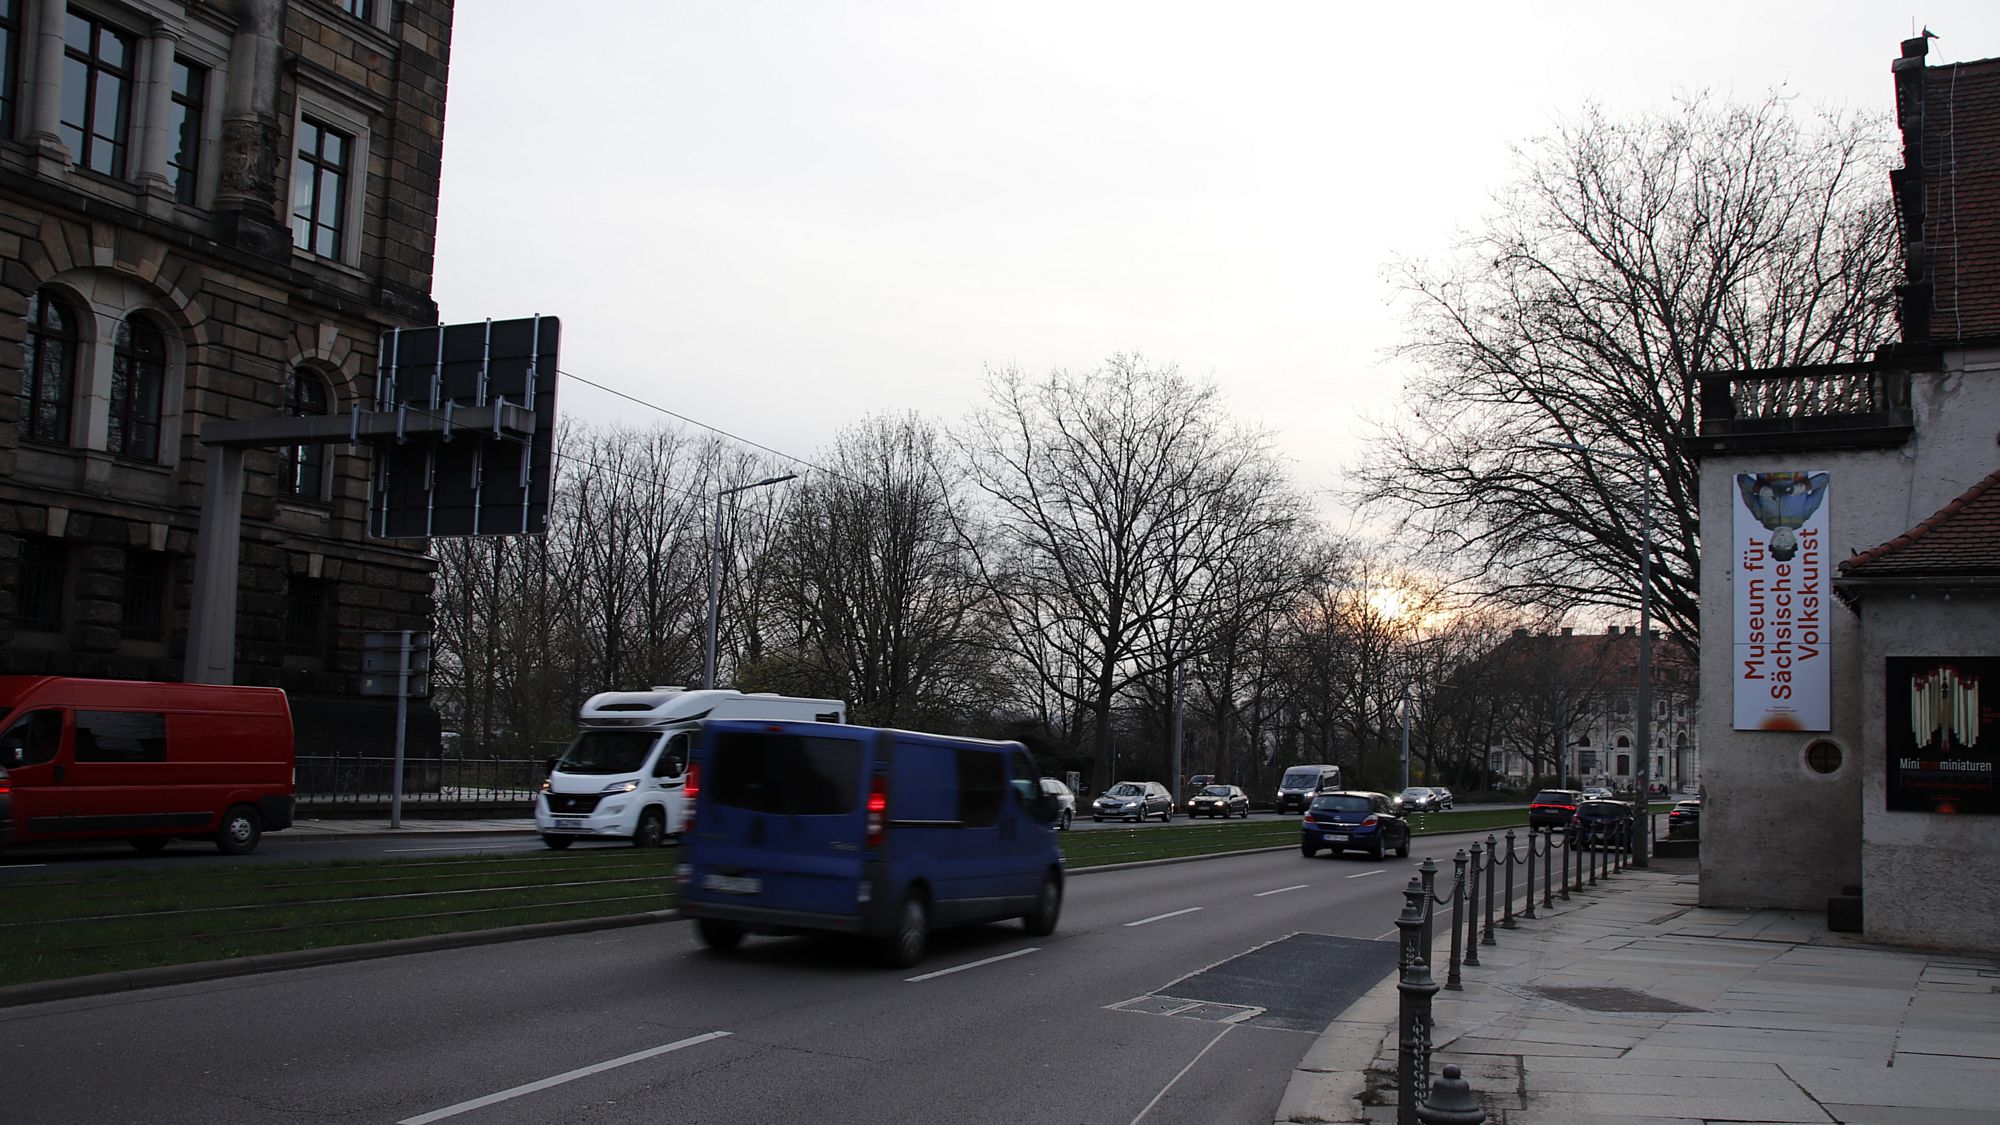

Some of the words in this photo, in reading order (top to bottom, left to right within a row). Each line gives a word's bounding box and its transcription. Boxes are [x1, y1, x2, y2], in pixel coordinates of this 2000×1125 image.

[1744, 538, 1765, 571] für
[1798, 528, 1819, 661] Volkskunst
[1744, 580, 1765, 680] Museum
[1771, 564, 1792, 700] Sächsische
